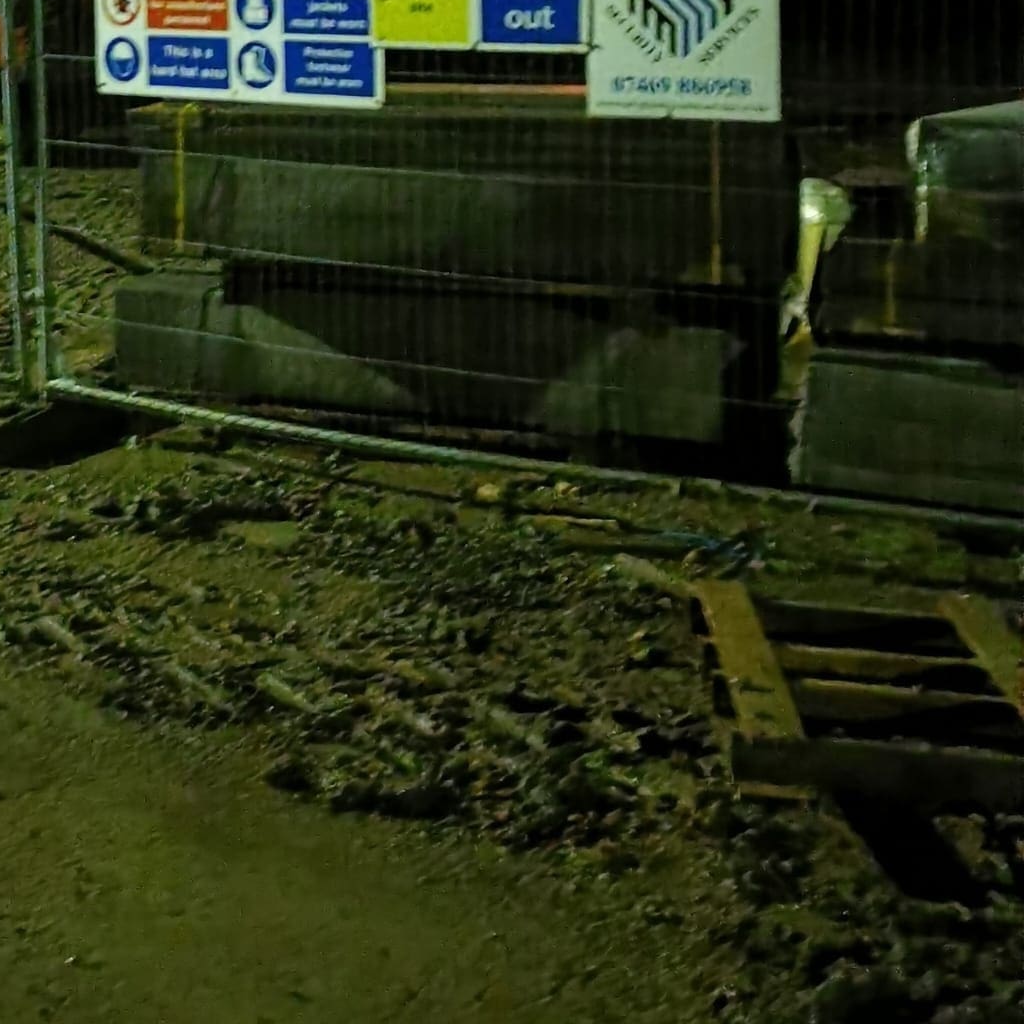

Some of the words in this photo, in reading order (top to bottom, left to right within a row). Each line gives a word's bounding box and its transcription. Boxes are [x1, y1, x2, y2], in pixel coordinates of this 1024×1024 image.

[503, 5, 556, 30] out
[163, 44, 189, 58] This
[199, 67, 228, 80] area
